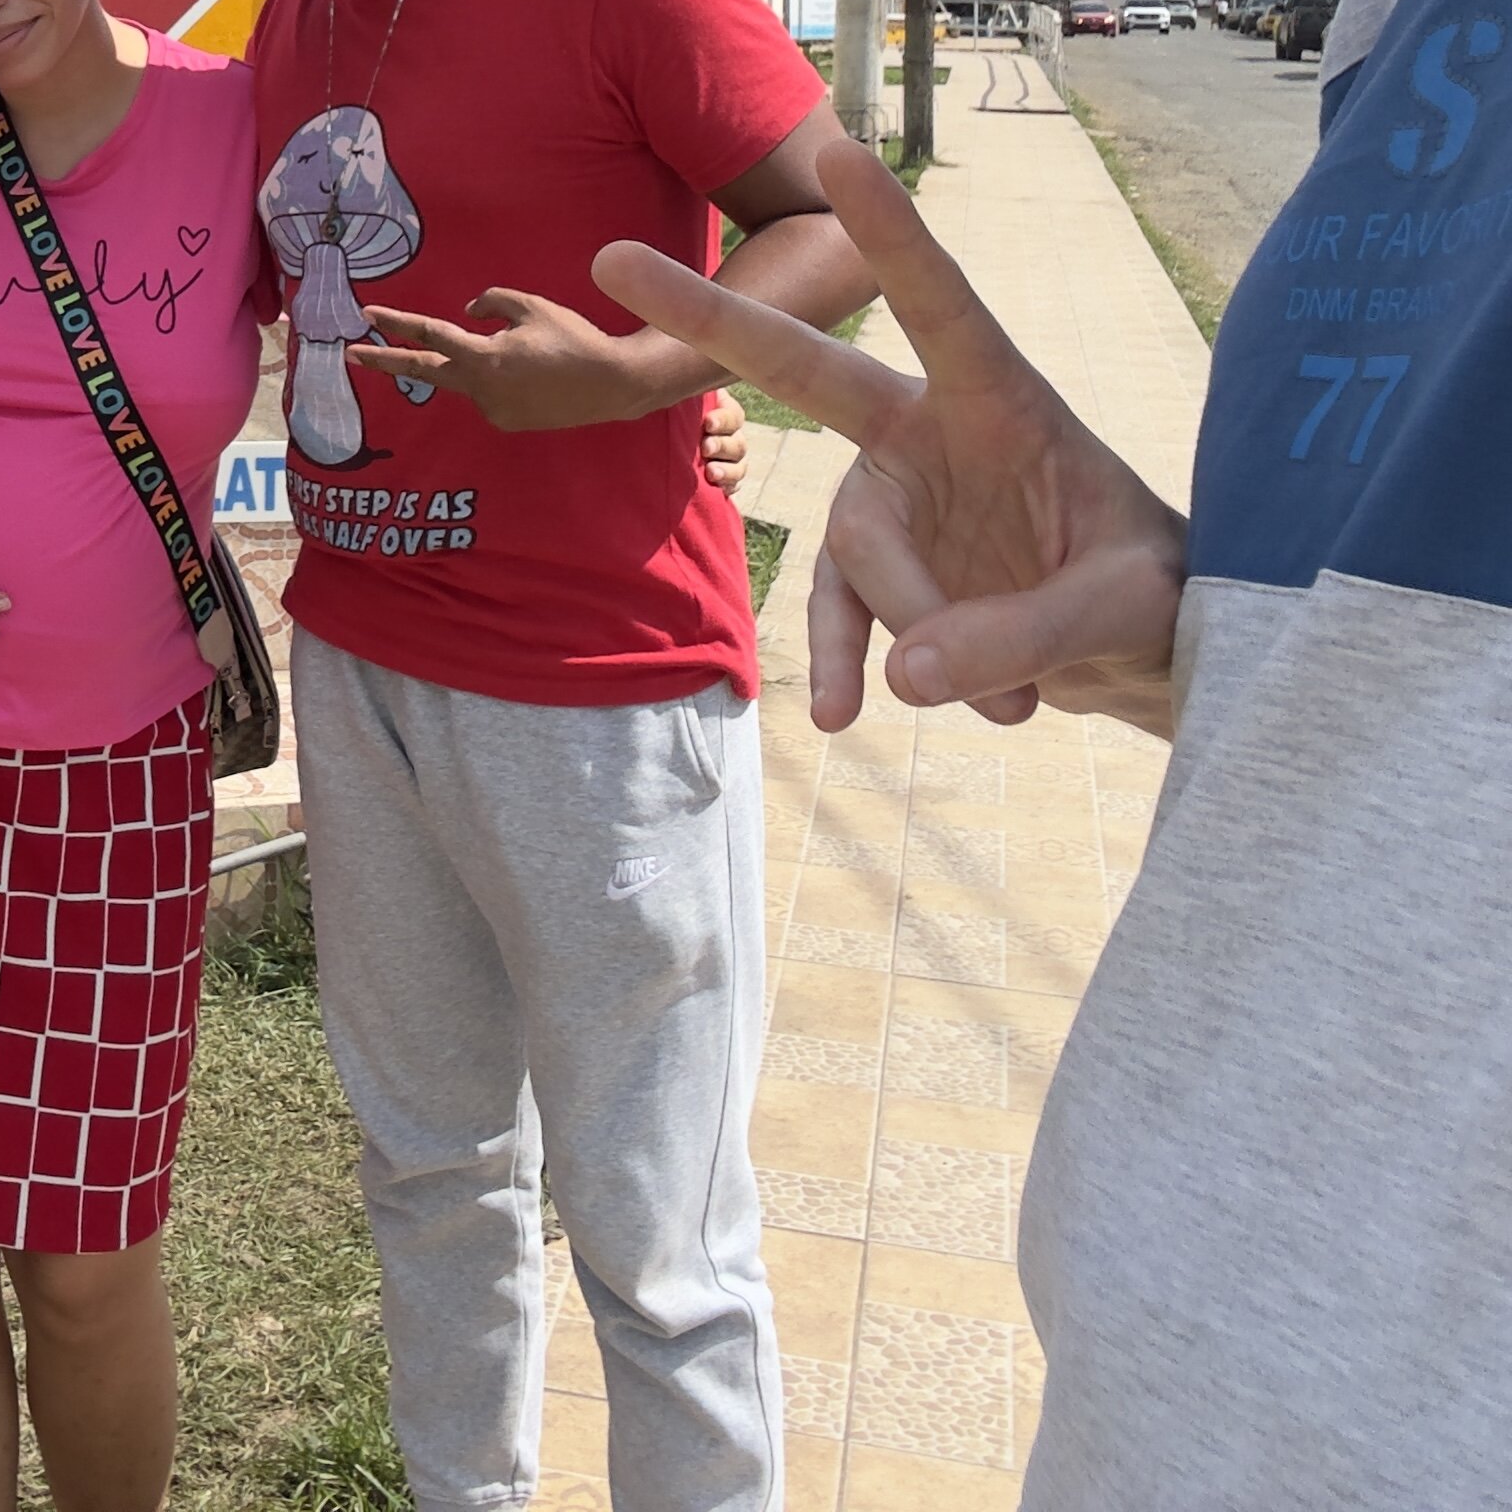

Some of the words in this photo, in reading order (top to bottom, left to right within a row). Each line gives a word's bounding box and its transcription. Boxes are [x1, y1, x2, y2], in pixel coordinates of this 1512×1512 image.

[1285, 288, 1358, 322] DNM
[23, 215, 74, 292] LOVE
[54, 292, 107, 372] LOVE
[87, 371, 146, 454] LOVE
[127, 451, 178, 527] LOVE
[164, 518, 203, 591] LOVE
[1289, 354, 1412, 465] 77
[214, 457, 287, 512] AT
[325, 487, 390, 517] STEP
[394, 491, 420, 519] IS
[427, 490, 474, 521] AS
[323, 518, 379, 552] HALF
[380, 527, 474, 556] OVER
[614, 855, 657, 883] NIKE
